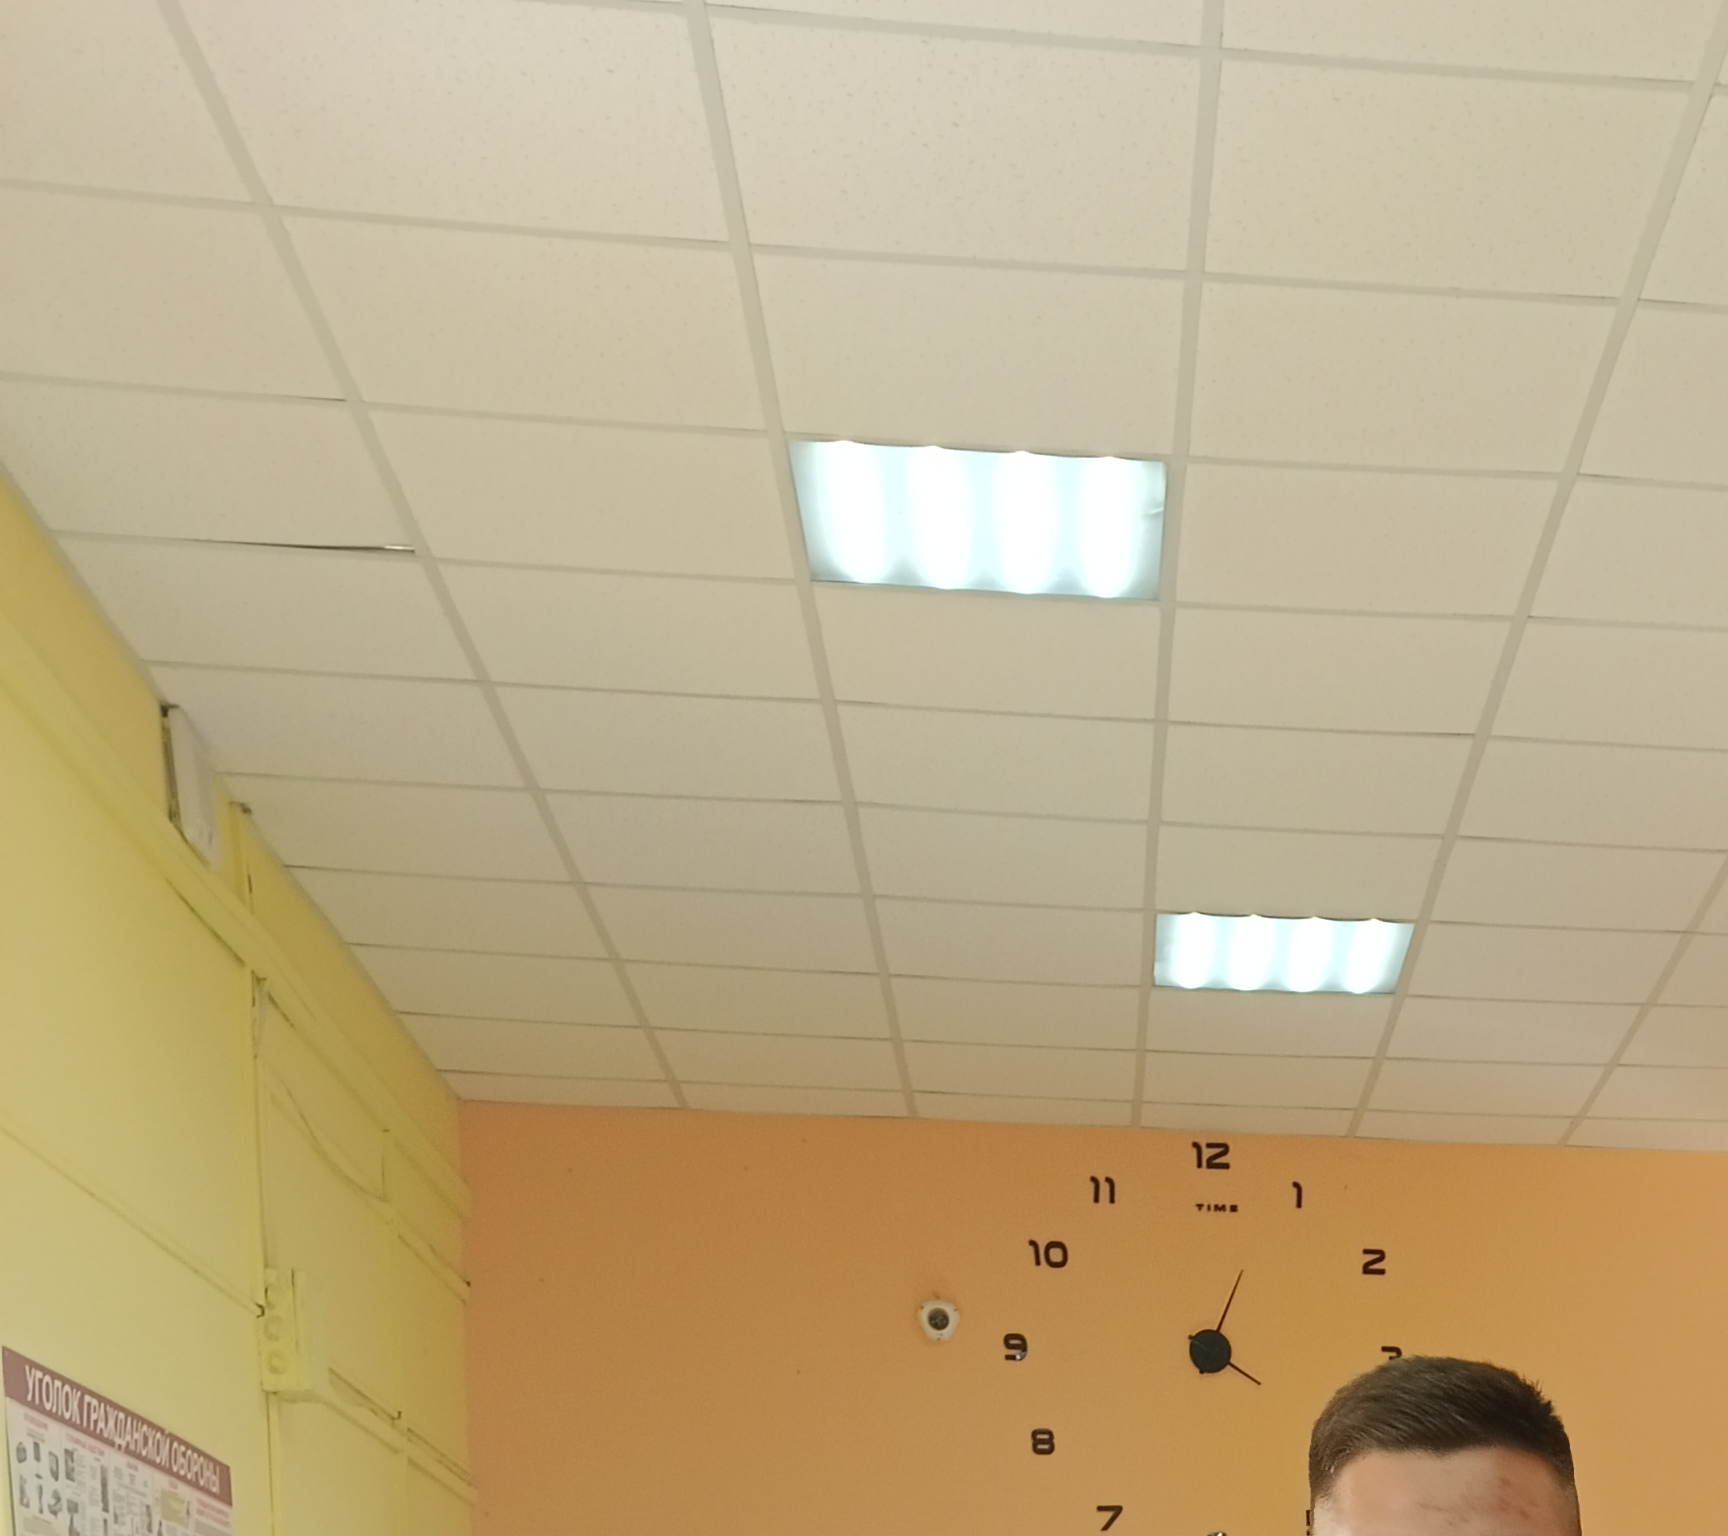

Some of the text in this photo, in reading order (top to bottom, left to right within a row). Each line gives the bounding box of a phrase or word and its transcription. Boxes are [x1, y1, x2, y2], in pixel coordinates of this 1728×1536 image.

[1192, 1142, 1230, 1169] 12
[1090, 1176, 1116, 1203] 11
[1292, 1181, 1302, 1208] 1
[1195, 1203, 1239, 1213] TIME
[1028, 1240, 1069, 1268] 10
[1362, 1249, 1387, 1275] 2
[1004, 1334, 1028, 1361] 9
[25, 1365, 220, 1494] УГОЛОК ГРАЖДАНСКОЙ ОБОРОНЫ
[1031, 1429, 1055, 1455] 8
[1097, 1505, 1123, 1531] 7
